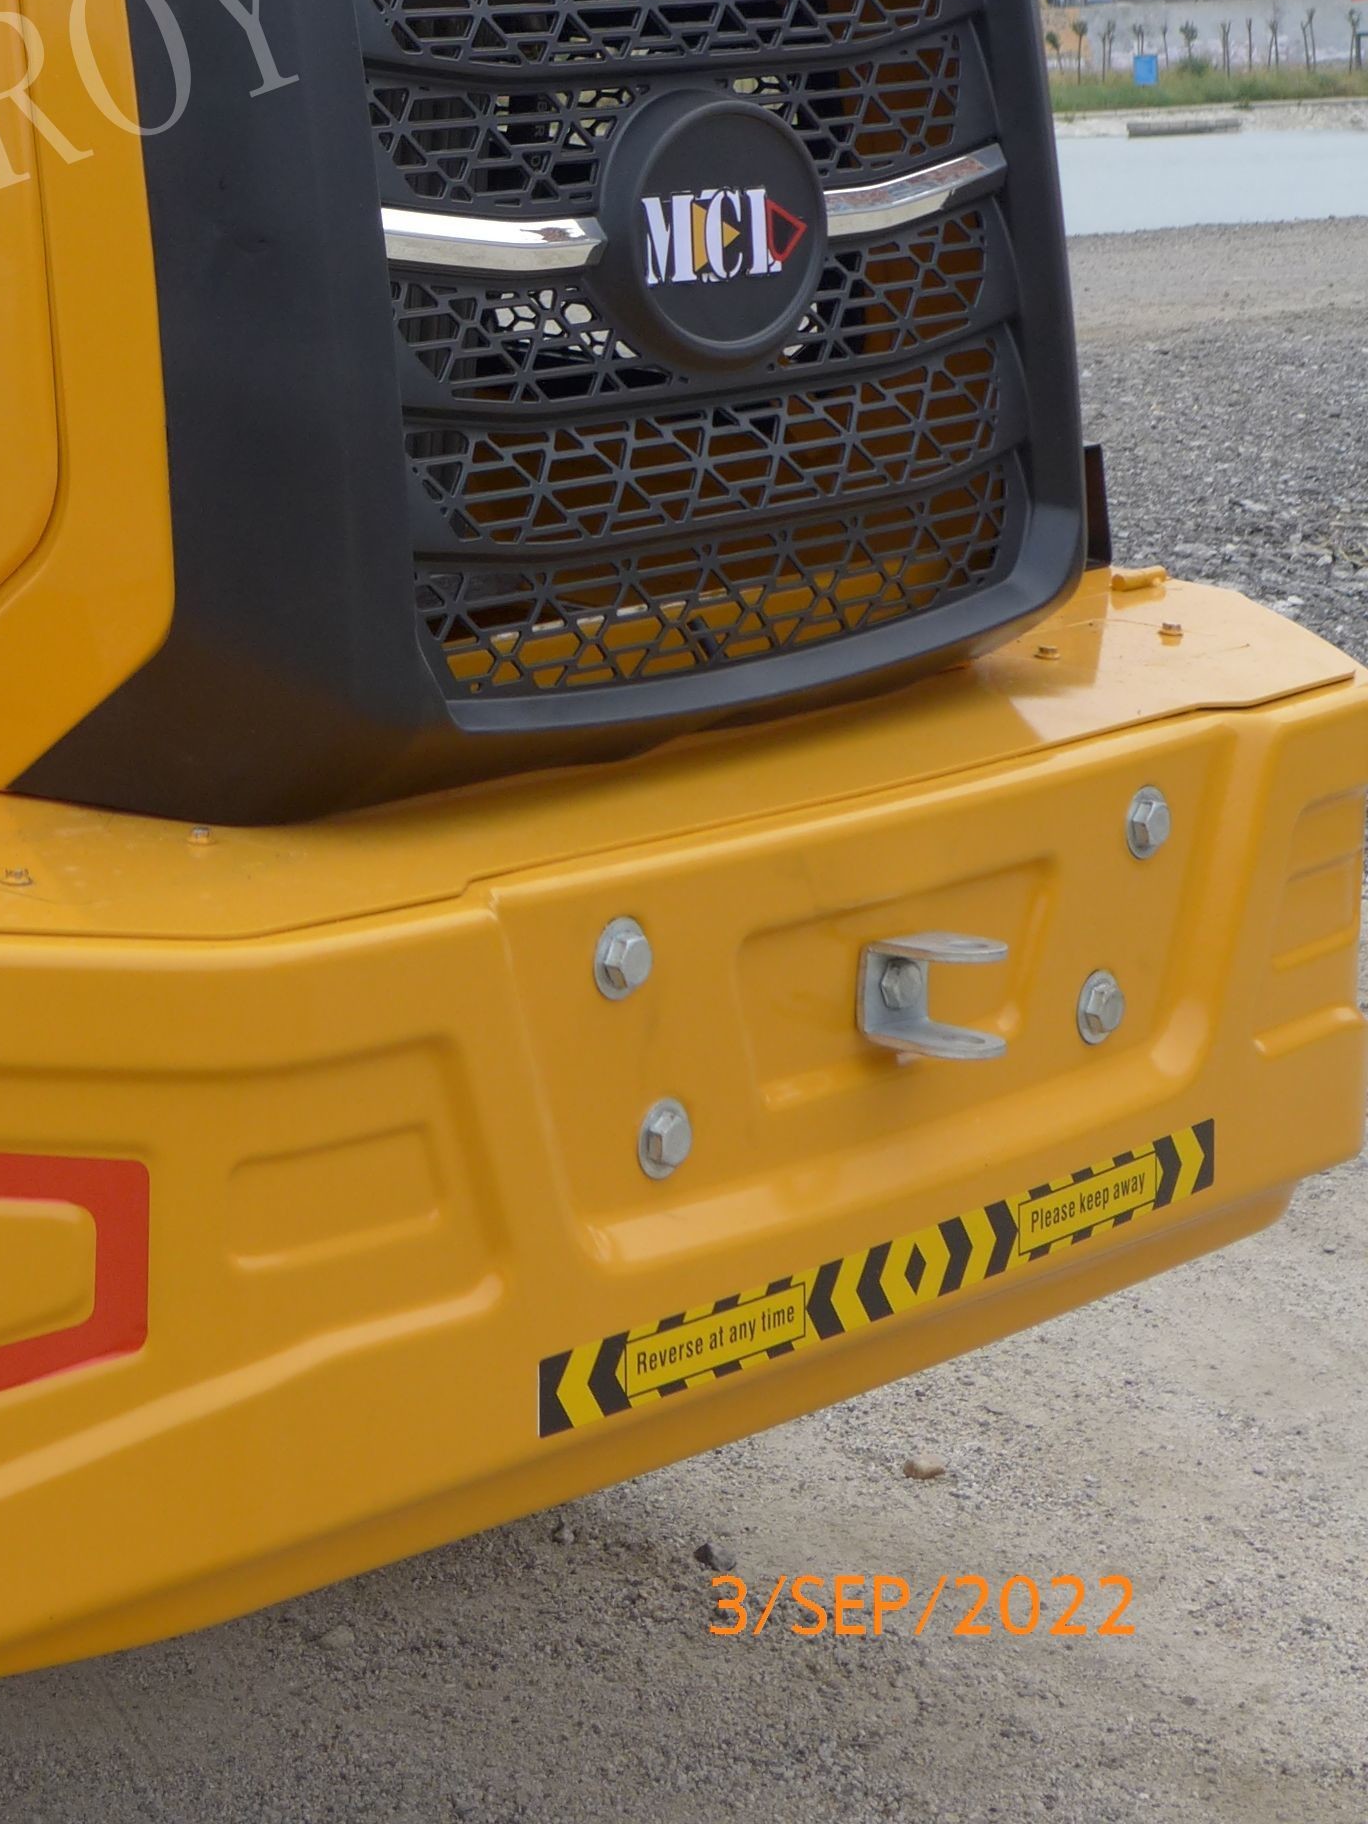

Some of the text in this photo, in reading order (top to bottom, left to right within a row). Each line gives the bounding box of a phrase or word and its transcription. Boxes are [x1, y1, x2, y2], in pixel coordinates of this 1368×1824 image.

[1031, 1172, 1146, 1233] Please keep away
[636, 1304, 795, 1376] Reverse at any time
